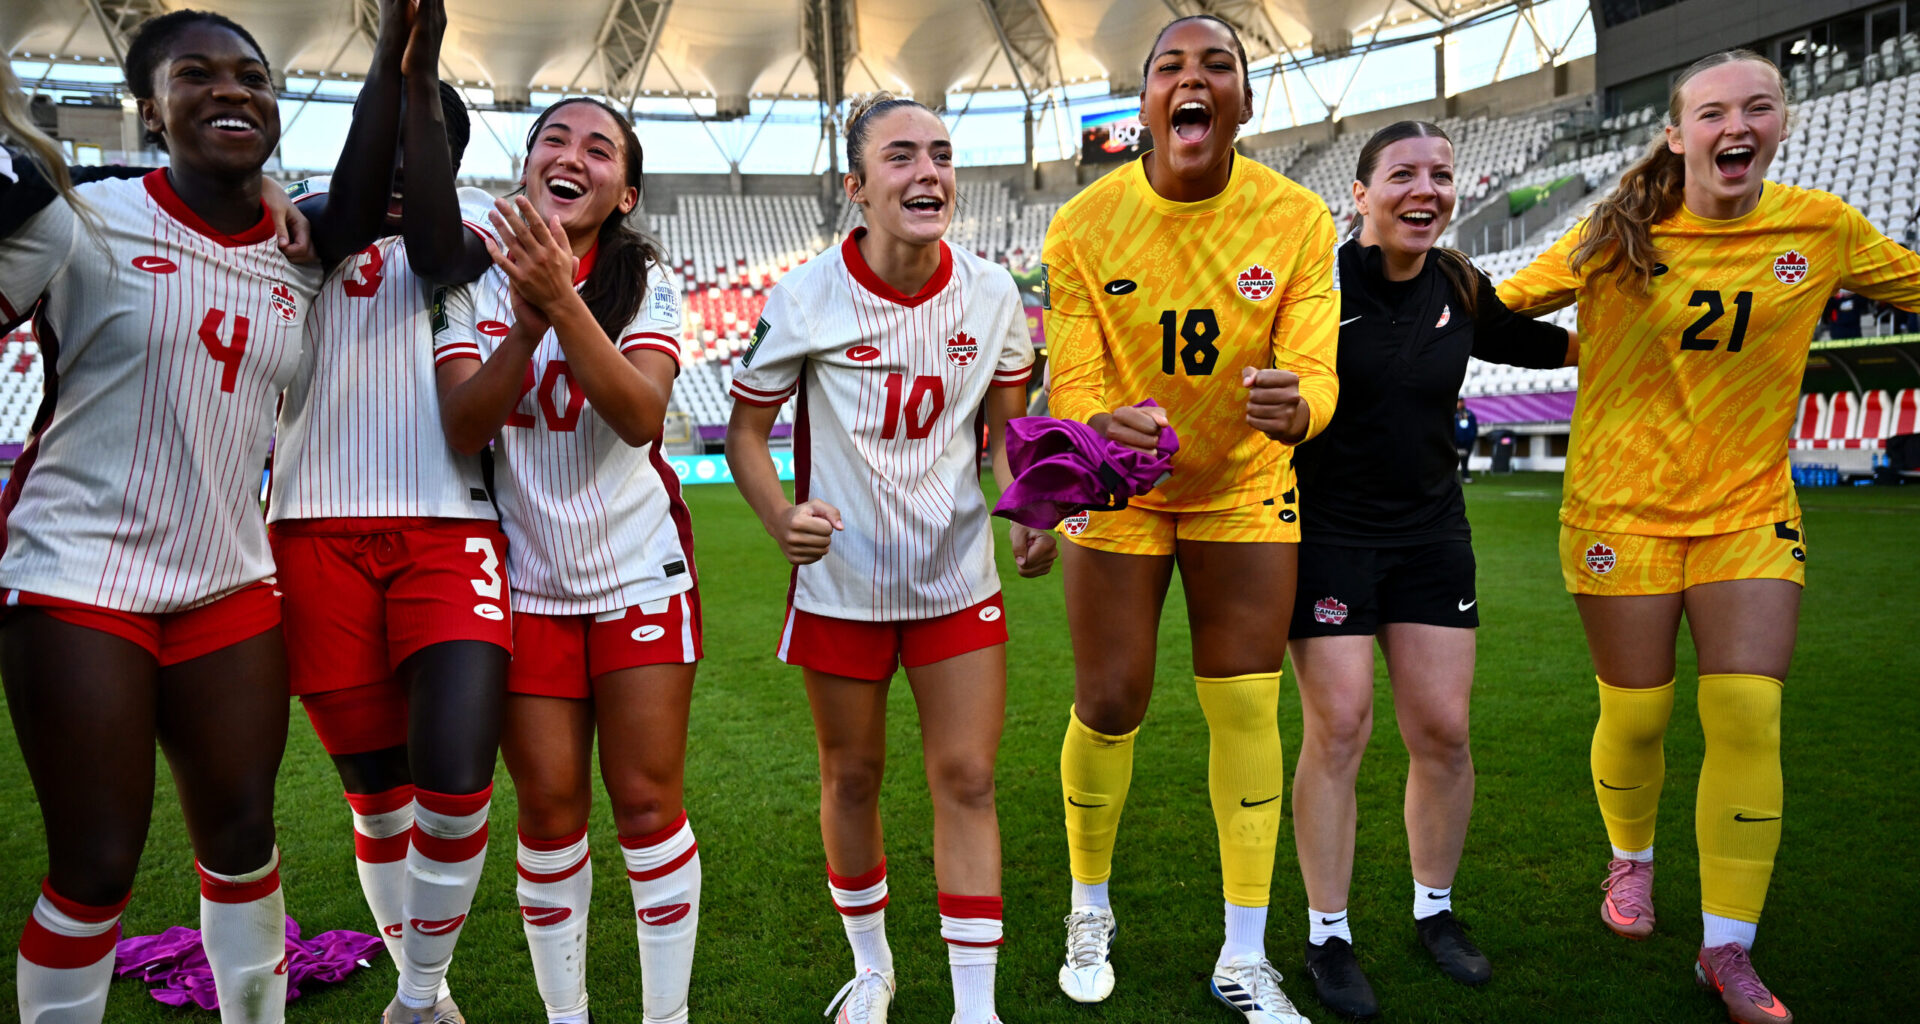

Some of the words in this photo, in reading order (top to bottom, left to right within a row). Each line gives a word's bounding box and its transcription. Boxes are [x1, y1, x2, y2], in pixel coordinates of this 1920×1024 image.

[344, 243, 384, 297] 3
[271, 294, 297, 310] CANADA
[1680, 290, 1753, 352] 21
[197, 307, 251, 393] 4
[1158, 308, 1221, 376] 18
[881, 372, 945, 440] 10
[464, 537, 502, 600] 3
[1314, 607, 1347, 616] CANADA
